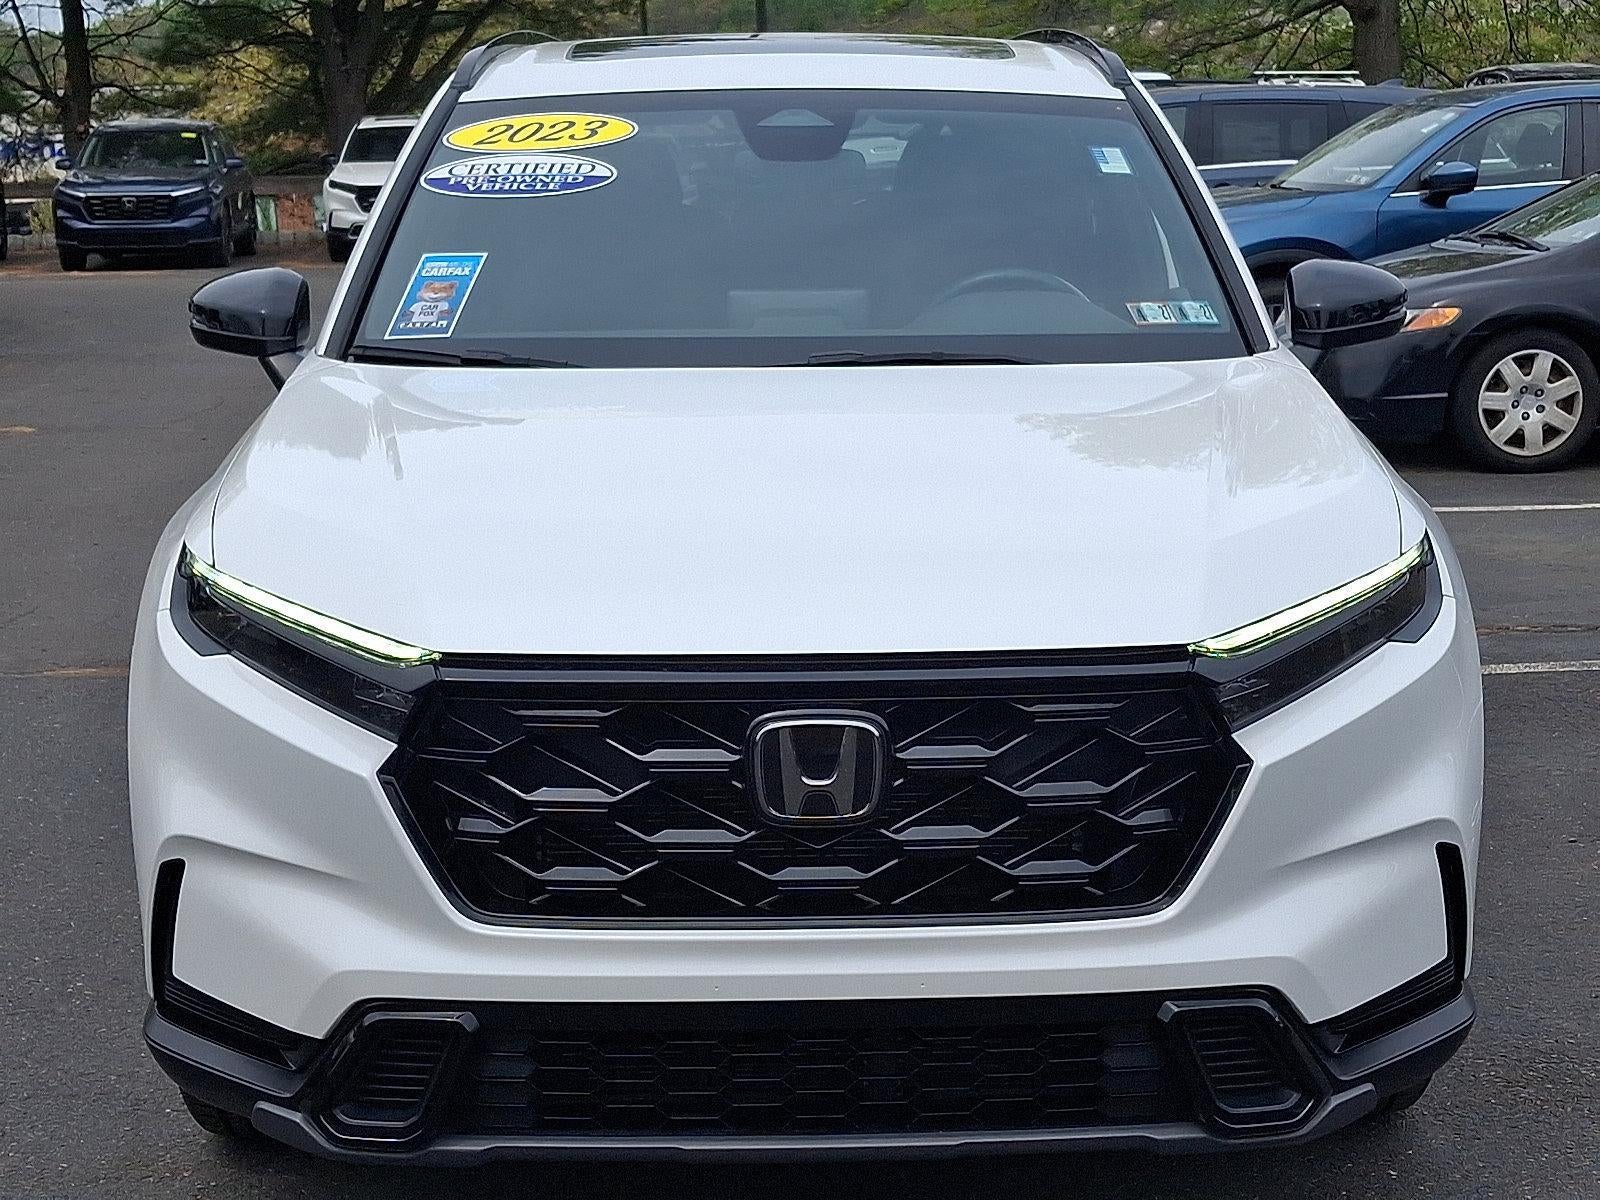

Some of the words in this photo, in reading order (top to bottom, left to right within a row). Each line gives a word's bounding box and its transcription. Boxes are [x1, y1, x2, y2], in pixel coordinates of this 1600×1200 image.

[472, 120, 609, 146] 2023
[448, 162, 597, 177] CERTIFIED
[448, 175, 585, 186] PRE-OWNED
[467, 182, 562, 192] VEHICLE
[421, 267, 472, 277] CARFAX
